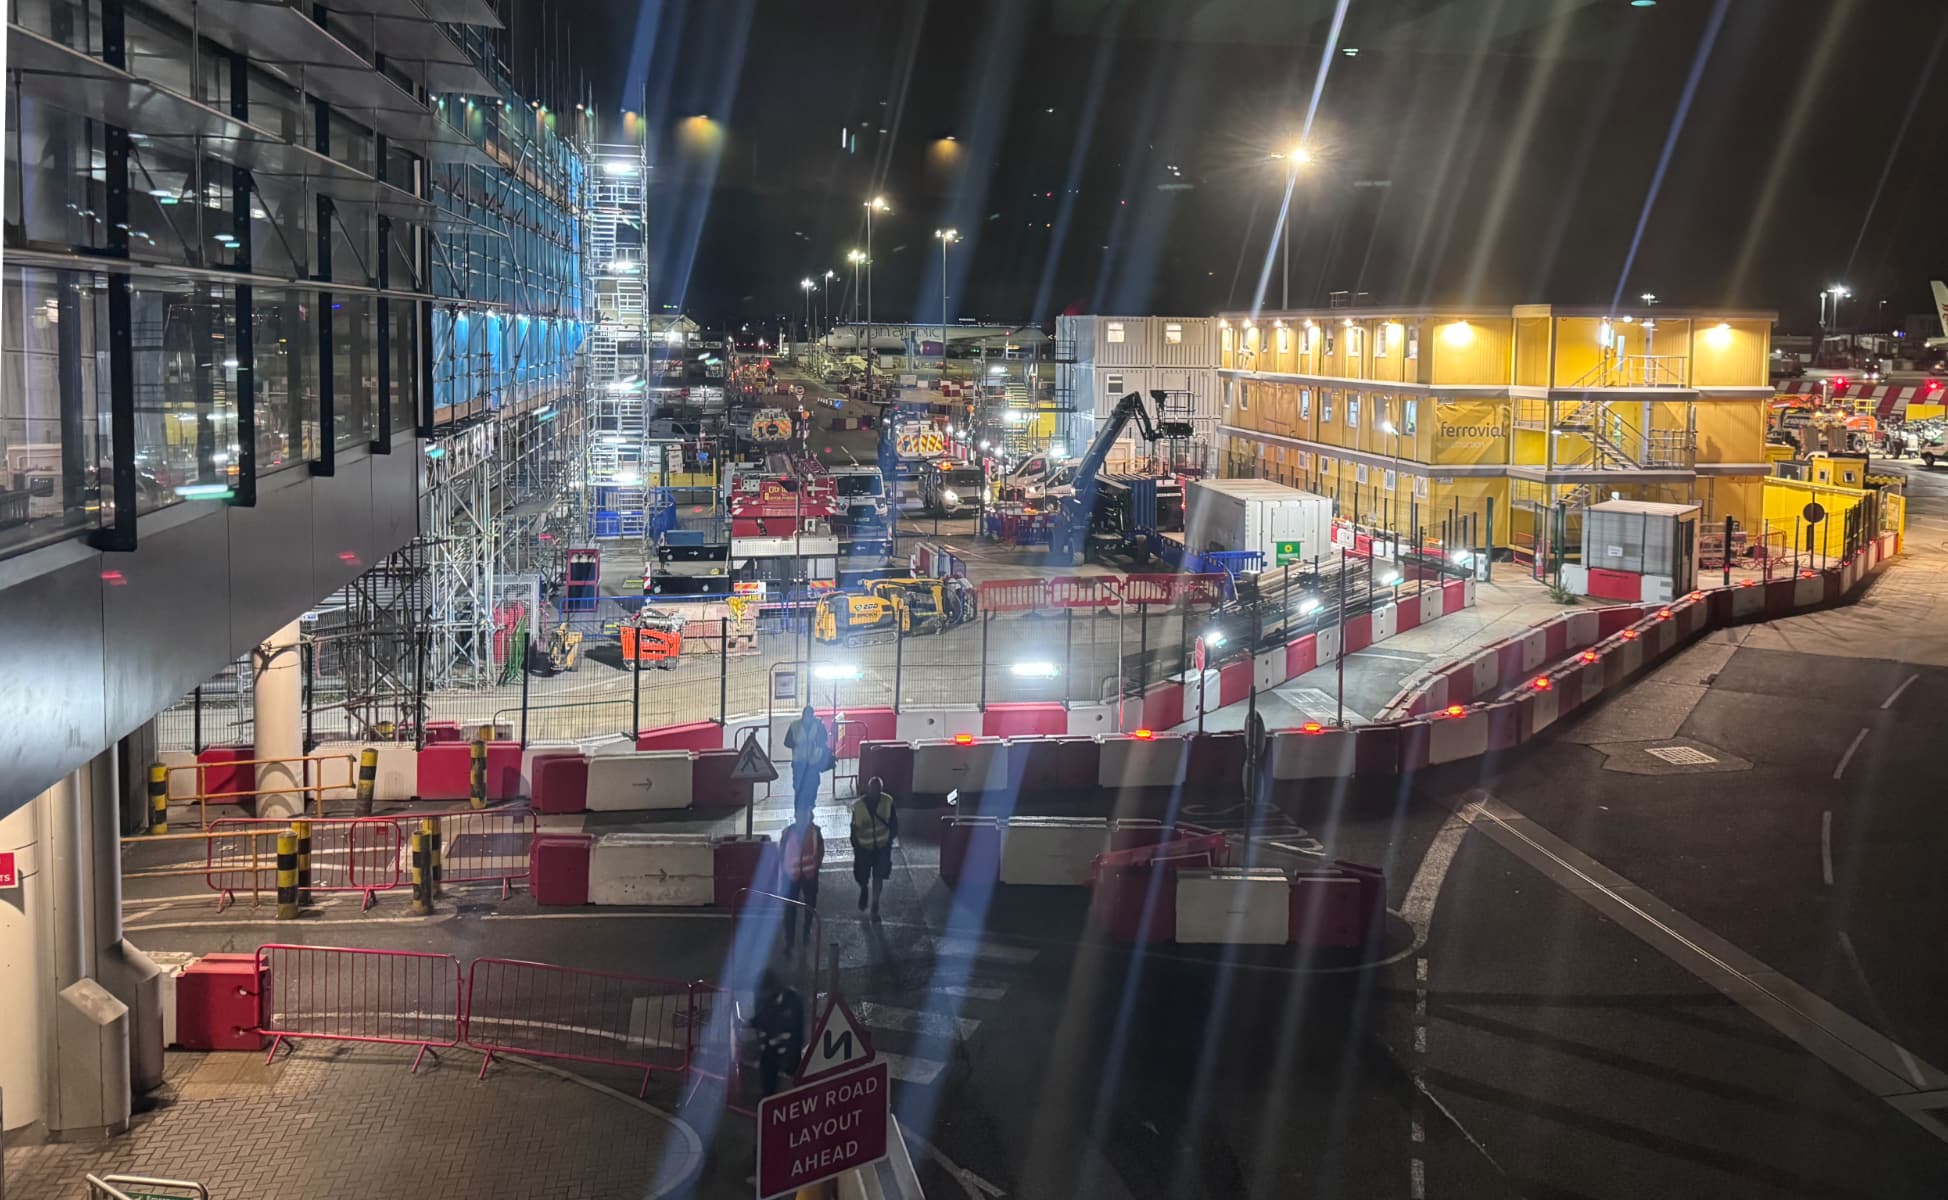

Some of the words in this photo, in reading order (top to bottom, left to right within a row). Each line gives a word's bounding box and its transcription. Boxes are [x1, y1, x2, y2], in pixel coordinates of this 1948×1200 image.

[849, 326, 890, 339] vrgin
[892, 326, 940, 337] atlntic
[1440, 421, 1507, 438] ferrovial
[773, 1095, 819, 1126] NEW
[825, 1078, 878, 1108] ROAD
[789, 1109, 863, 1148] LAYOUT
[791, 1140, 858, 1177] AHEAD
